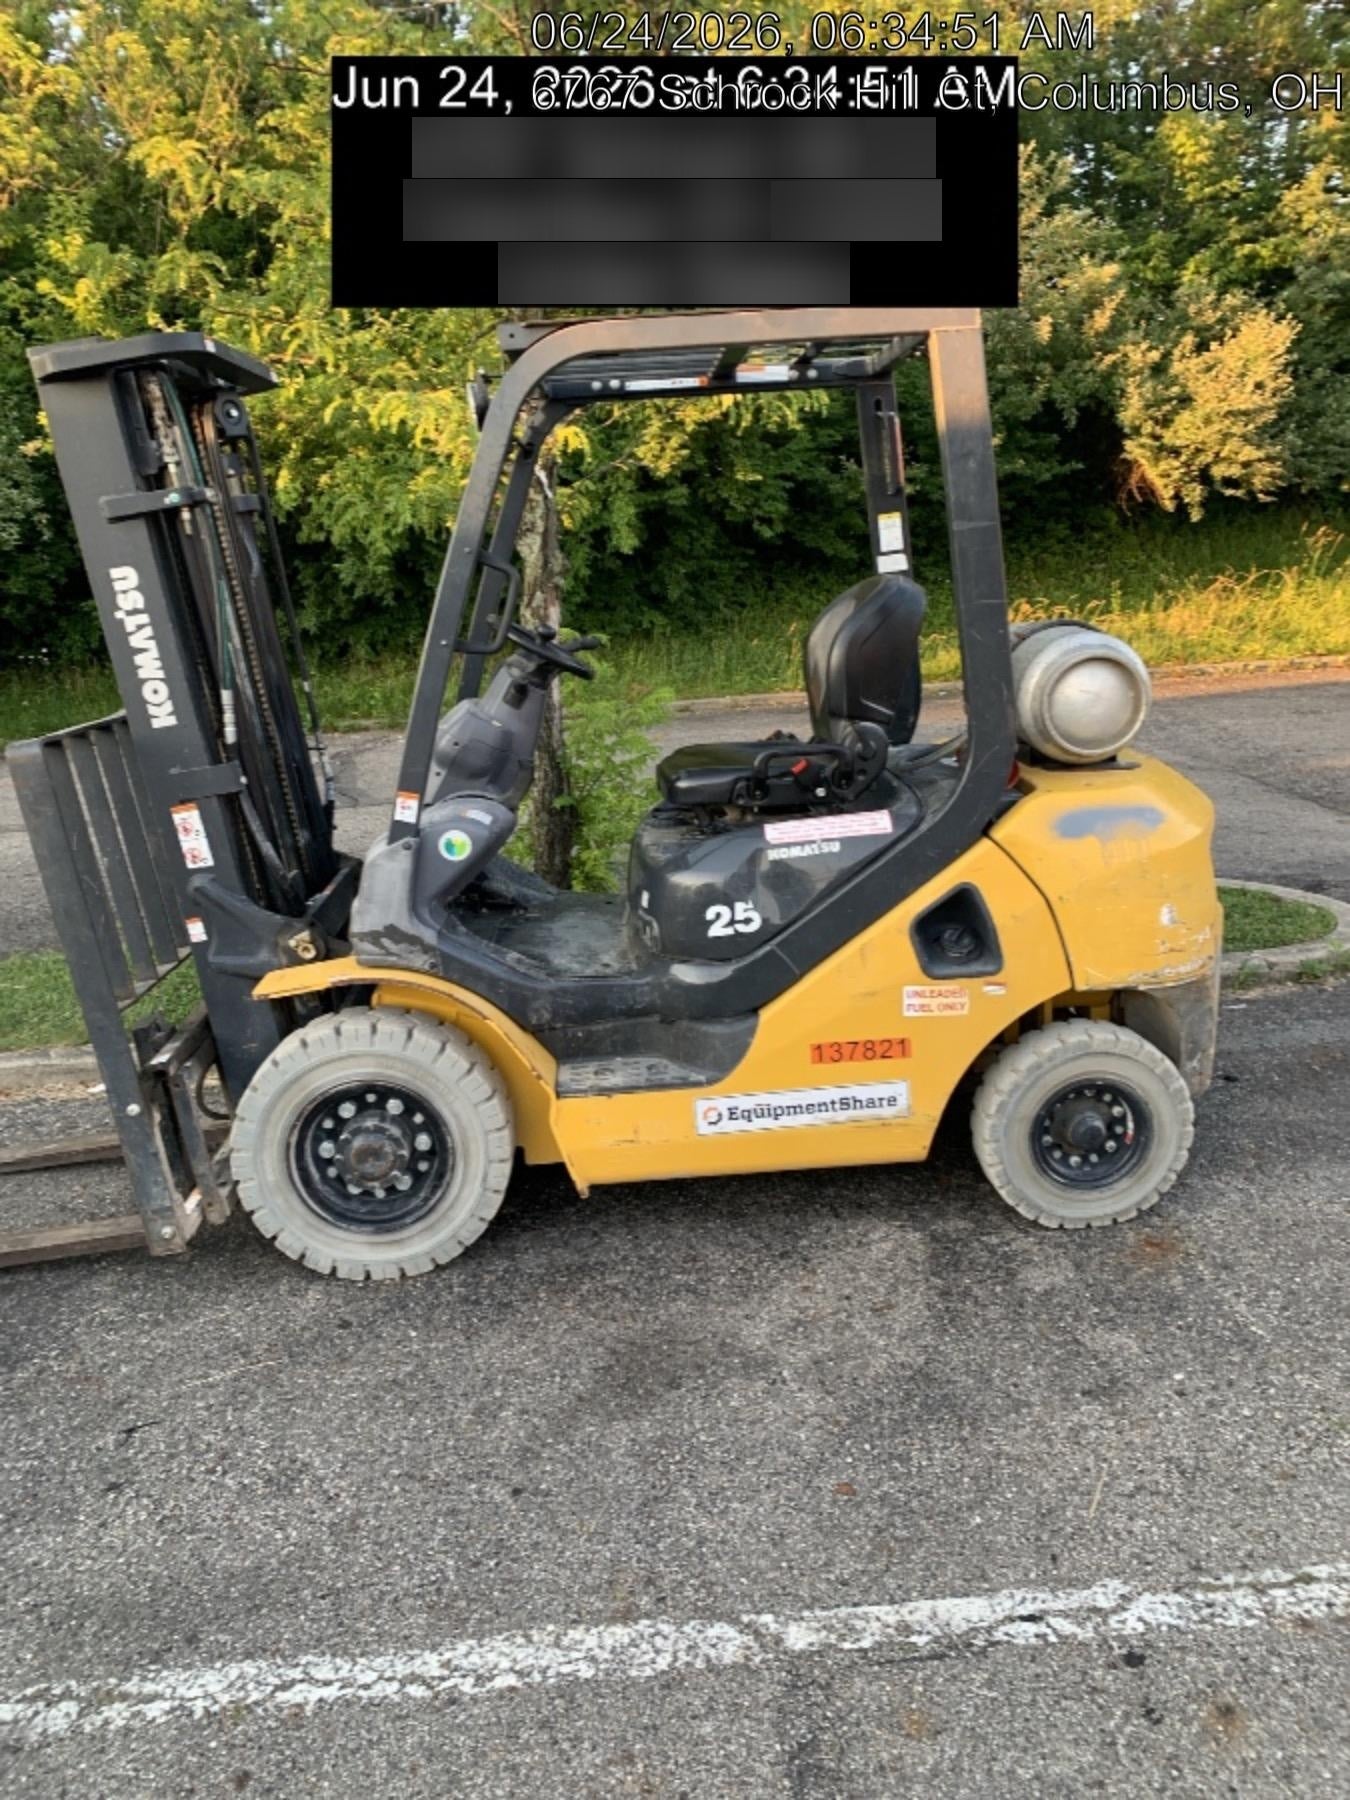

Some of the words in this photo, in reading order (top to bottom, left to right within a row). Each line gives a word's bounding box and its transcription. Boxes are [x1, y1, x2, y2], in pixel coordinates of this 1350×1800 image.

[109, 565, 179, 729] KOMATSU
[767, 839, 841, 861] KOMATSU
[705, 899, 763, 938] 25
[905, 1003, 935, 1014] FUEL
[937, 1001, 967, 1013] ONLY
[812, 1038, 909, 1063] 137821
[726, 1094, 899, 1123] EquipmentShare
